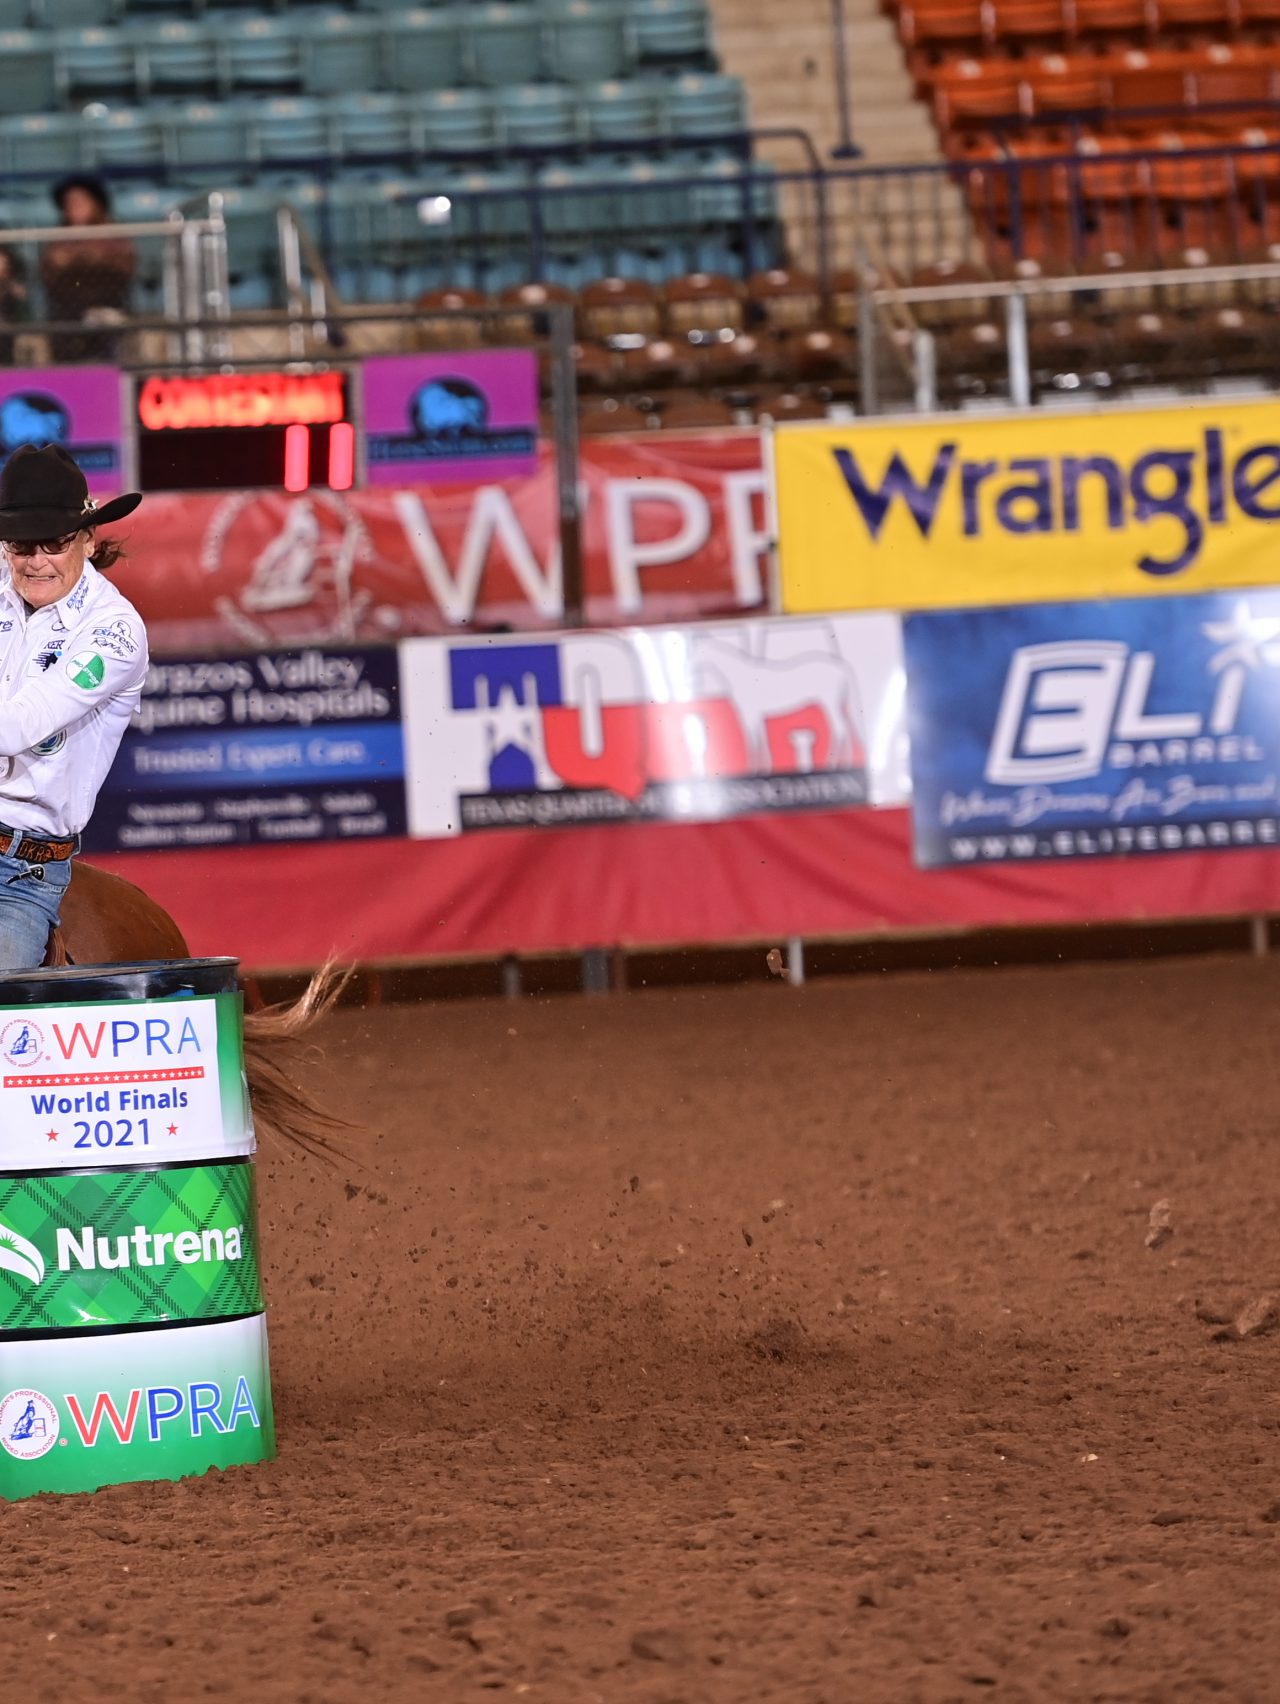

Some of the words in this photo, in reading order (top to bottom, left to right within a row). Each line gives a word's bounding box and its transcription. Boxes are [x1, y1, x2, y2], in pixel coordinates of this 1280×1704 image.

[284, 424, 355, 492] 11
[256, 650, 365, 690] Valley
[231, 682, 391, 727] Hospitals
[52, 1017, 202, 1061] WPRA
[31, 1091, 111, 1115] World
[119, 1087, 189, 1112] Finals
[73, 1118, 150, 1149] 2021
[56, 1225, 242, 1271] Nutrena
[64, 1375, 261, 1447] WPRA
